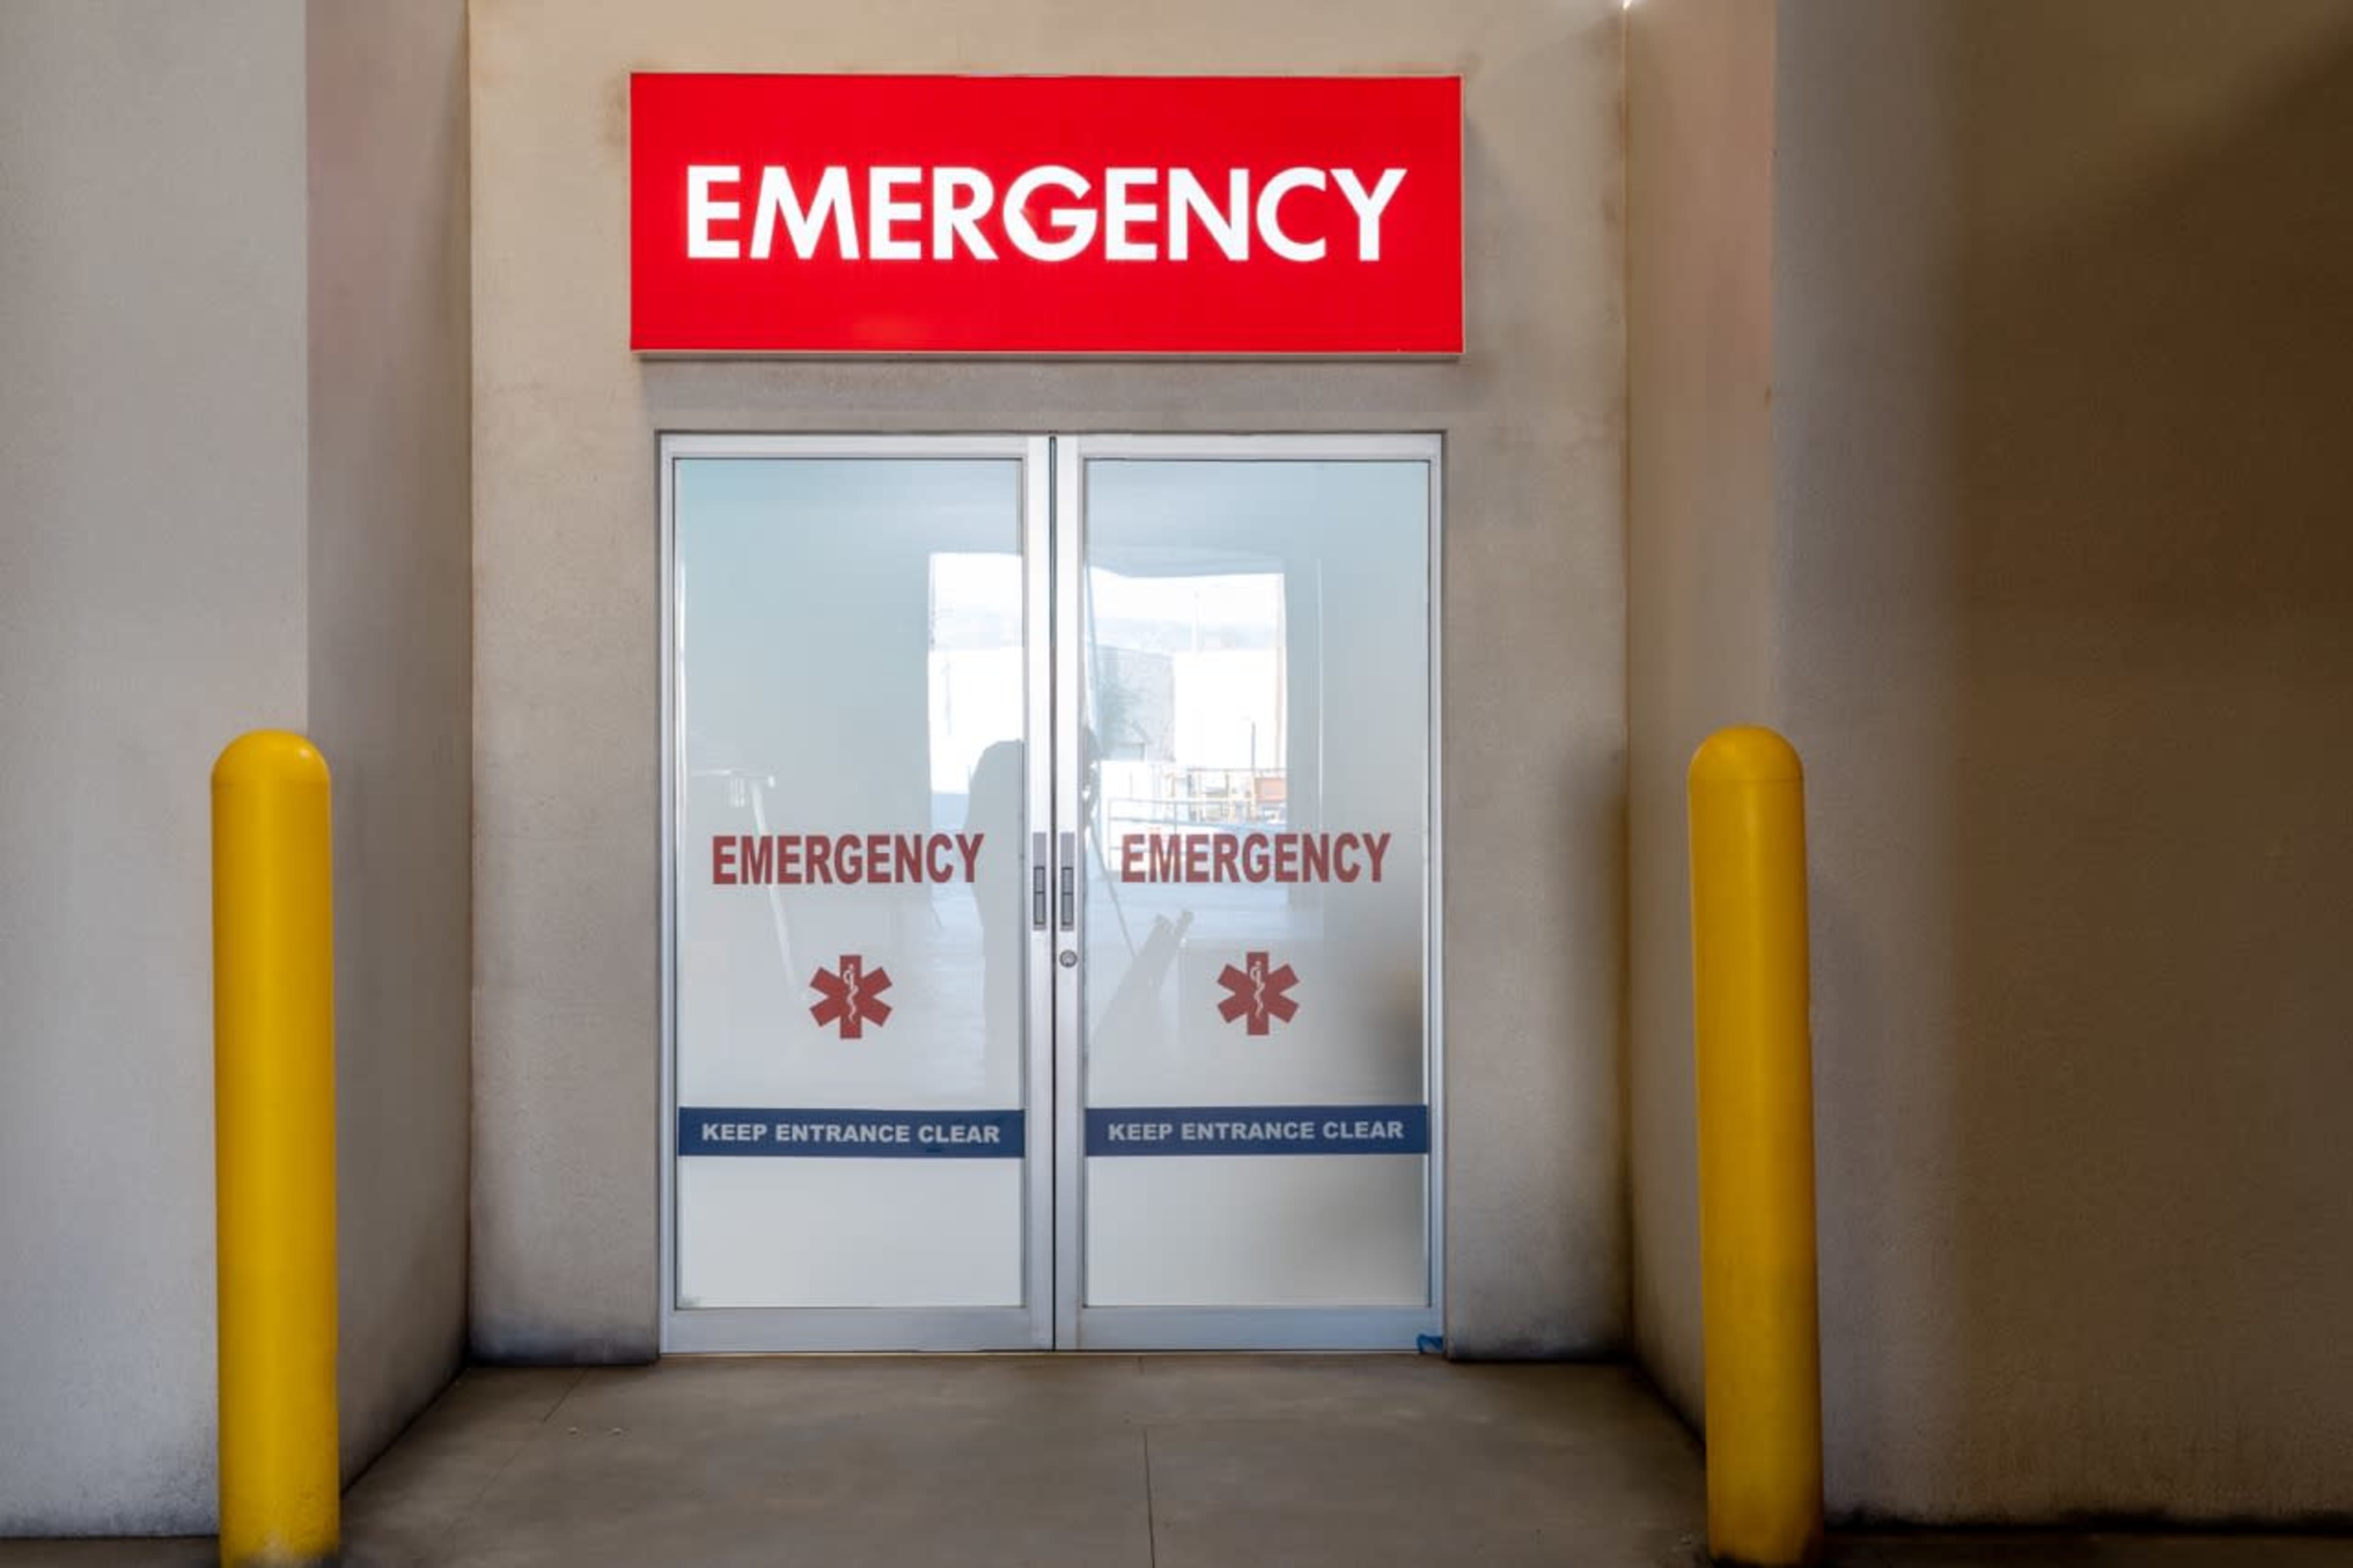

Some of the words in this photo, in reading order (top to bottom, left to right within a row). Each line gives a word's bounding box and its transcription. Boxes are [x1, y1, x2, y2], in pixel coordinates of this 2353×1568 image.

[686, 165, 1408, 262] EMERGENCY
[712, 833, 985, 885] EMERGENCY
[1121, 833, 1392, 883] EMERGENCY
[702, 1123, 767, 1141] KEEP
[775, 1124, 911, 1142] ENTRANCE
[917, 1125, 1000, 1144] CLEAR
[1108, 1123, 1173, 1141] KEEP
[1181, 1122, 1314, 1140] ENTRANCE
[1322, 1121, 1404, 1139] CLEAR
